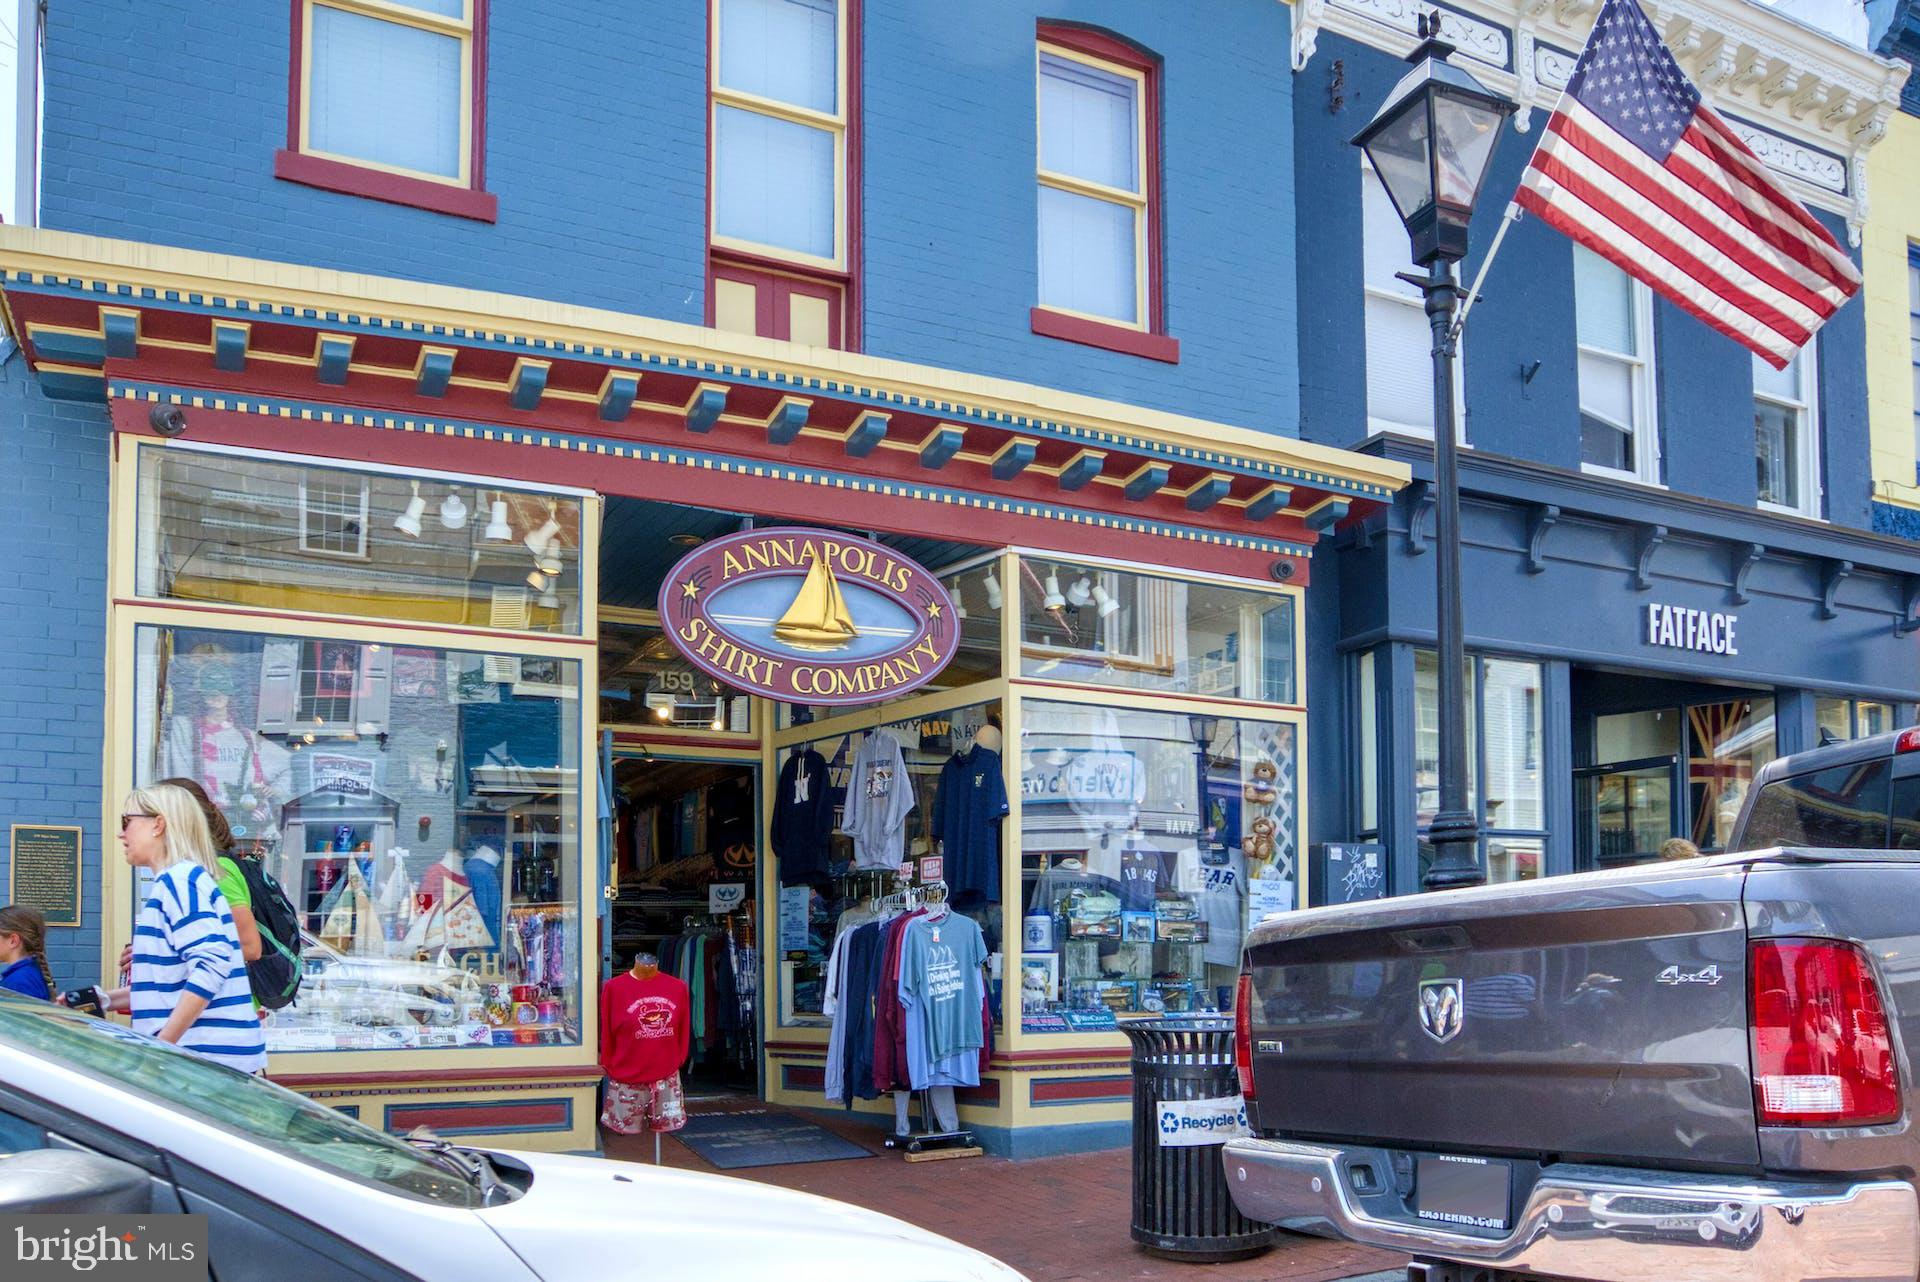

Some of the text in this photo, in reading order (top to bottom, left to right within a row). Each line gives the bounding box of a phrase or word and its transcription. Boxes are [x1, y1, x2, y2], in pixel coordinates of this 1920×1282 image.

[722, 539, 913, 594] ANNAPOLIS
[1649, 603, 1738, 655] FATFACE
[679, 617, 942, 696] SHIRT COMPANY
[656, 671, 694, 690] 159
[316, 778, 369, 791] ANNAPOLIS
[1165, 819, 1195, 835] NAVY
[1655, 964, 1723, 986] 4x4
[1181, 1114, 1235, 1130] Recycle
[1418, 1210, 1504, 1229] EASTERNS.COM
